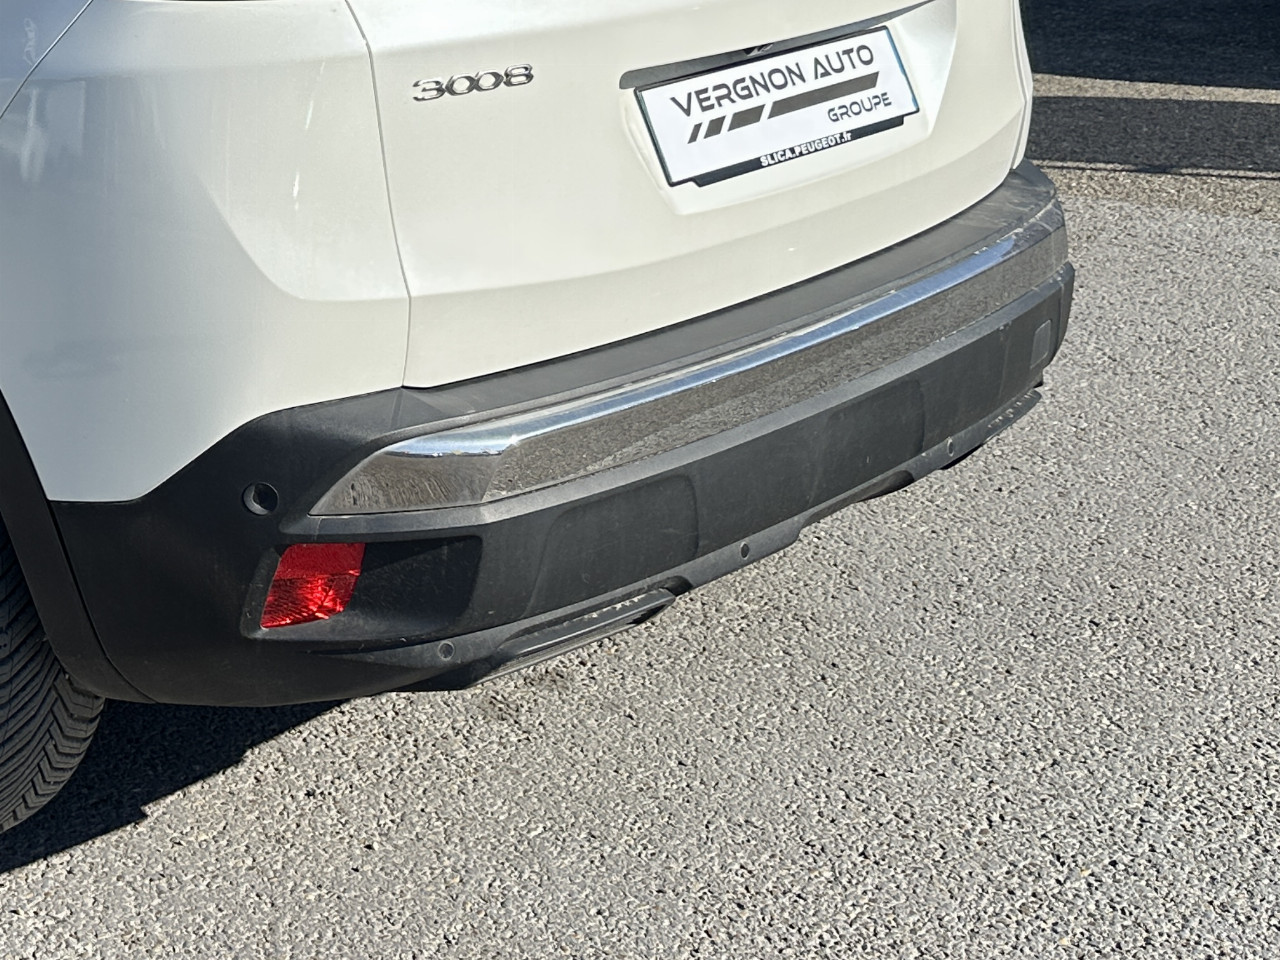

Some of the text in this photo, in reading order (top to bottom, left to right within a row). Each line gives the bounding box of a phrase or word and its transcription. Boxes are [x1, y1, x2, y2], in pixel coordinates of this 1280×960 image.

[412, 63, 535, 103] 3008
[670, 44, 875, 117] VERGNON AUTO
[827, 92, 893, 123] GROUPE
[759, 131, 853, 168] SLICA.PEUGEOT.fr
